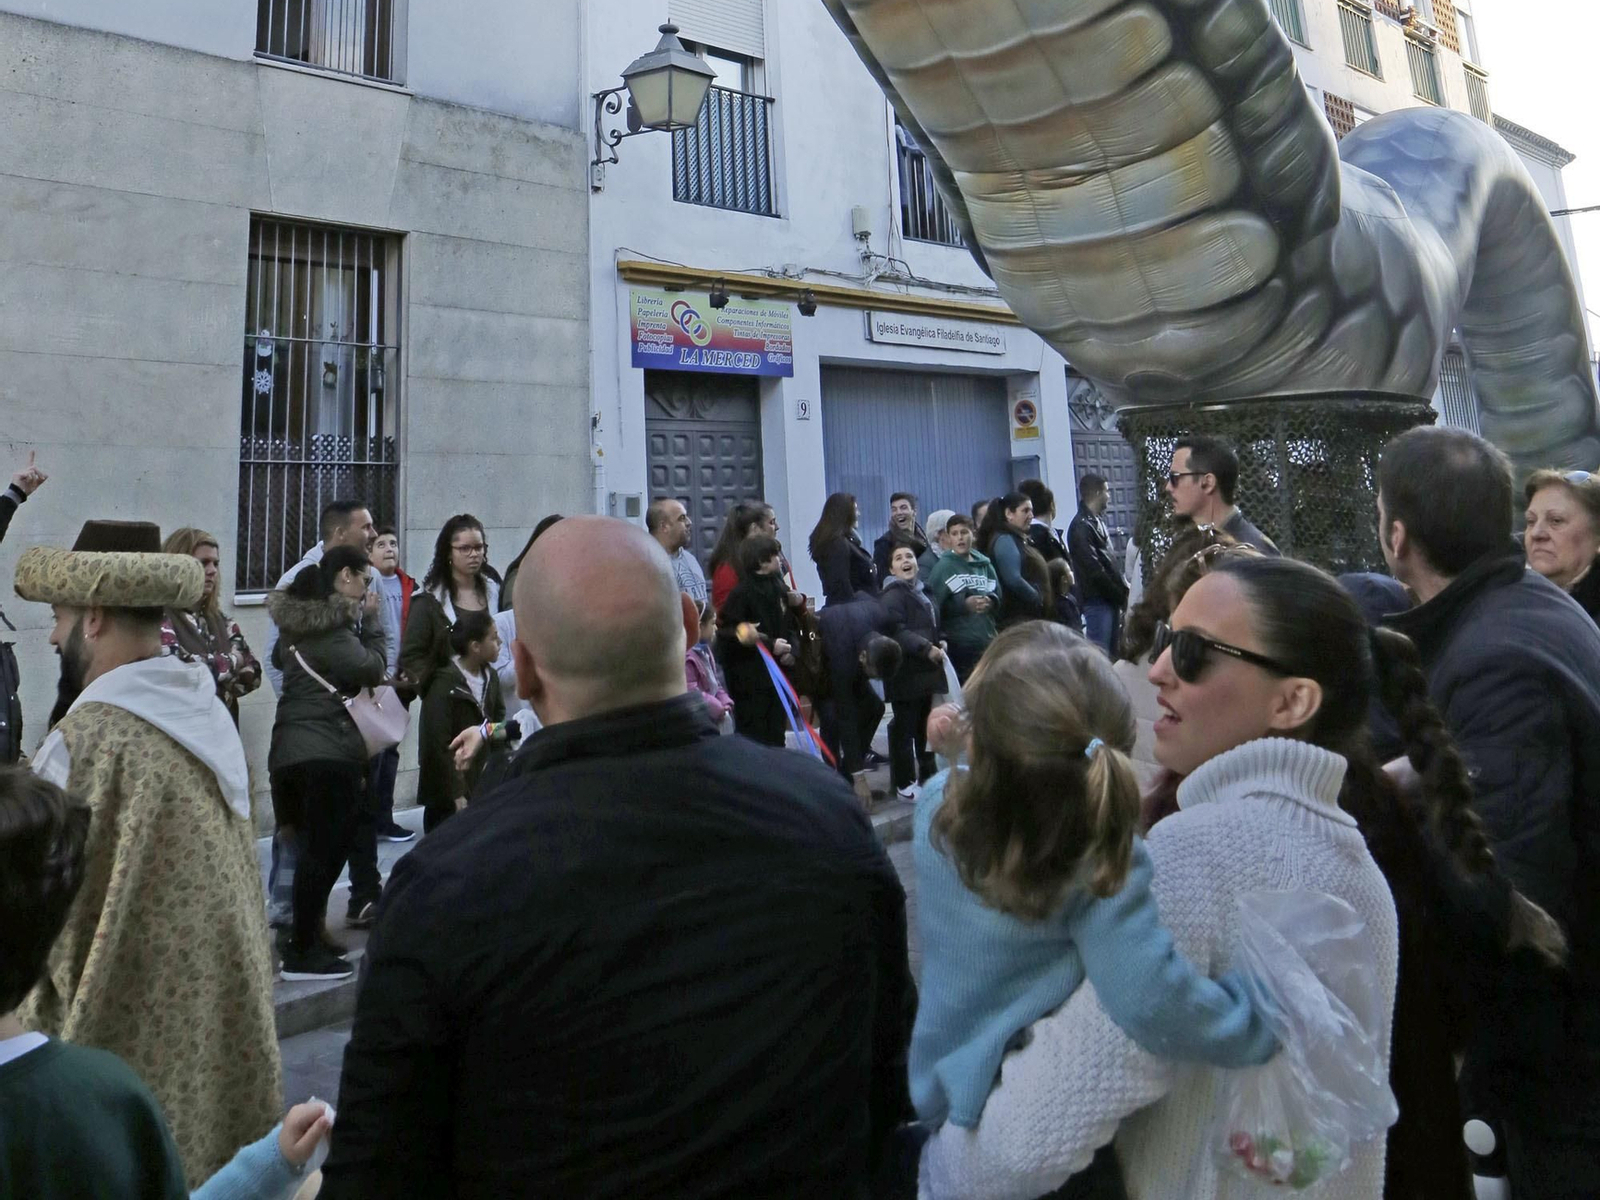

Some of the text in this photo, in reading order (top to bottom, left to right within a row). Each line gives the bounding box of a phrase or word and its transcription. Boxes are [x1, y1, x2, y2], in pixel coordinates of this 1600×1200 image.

[760, 309, 767, 317] de
[637, 319, 667, 330] Imprenta
[716, 315, 755, 327] Componentes
[637, 330, 674, 344] Fotocopias
[734, 327, 790, 342] Tintas de Impresoras
[876, 321, 1001, 348] Iglesia Evangélica Filadelfia de Santiago
[638, 342, 674, 354] Publicidad
[764, 342, 791, 352] Bordados
[679, 348, 762, 369] LA MERCED
[800, 401, 807, 416] 9
